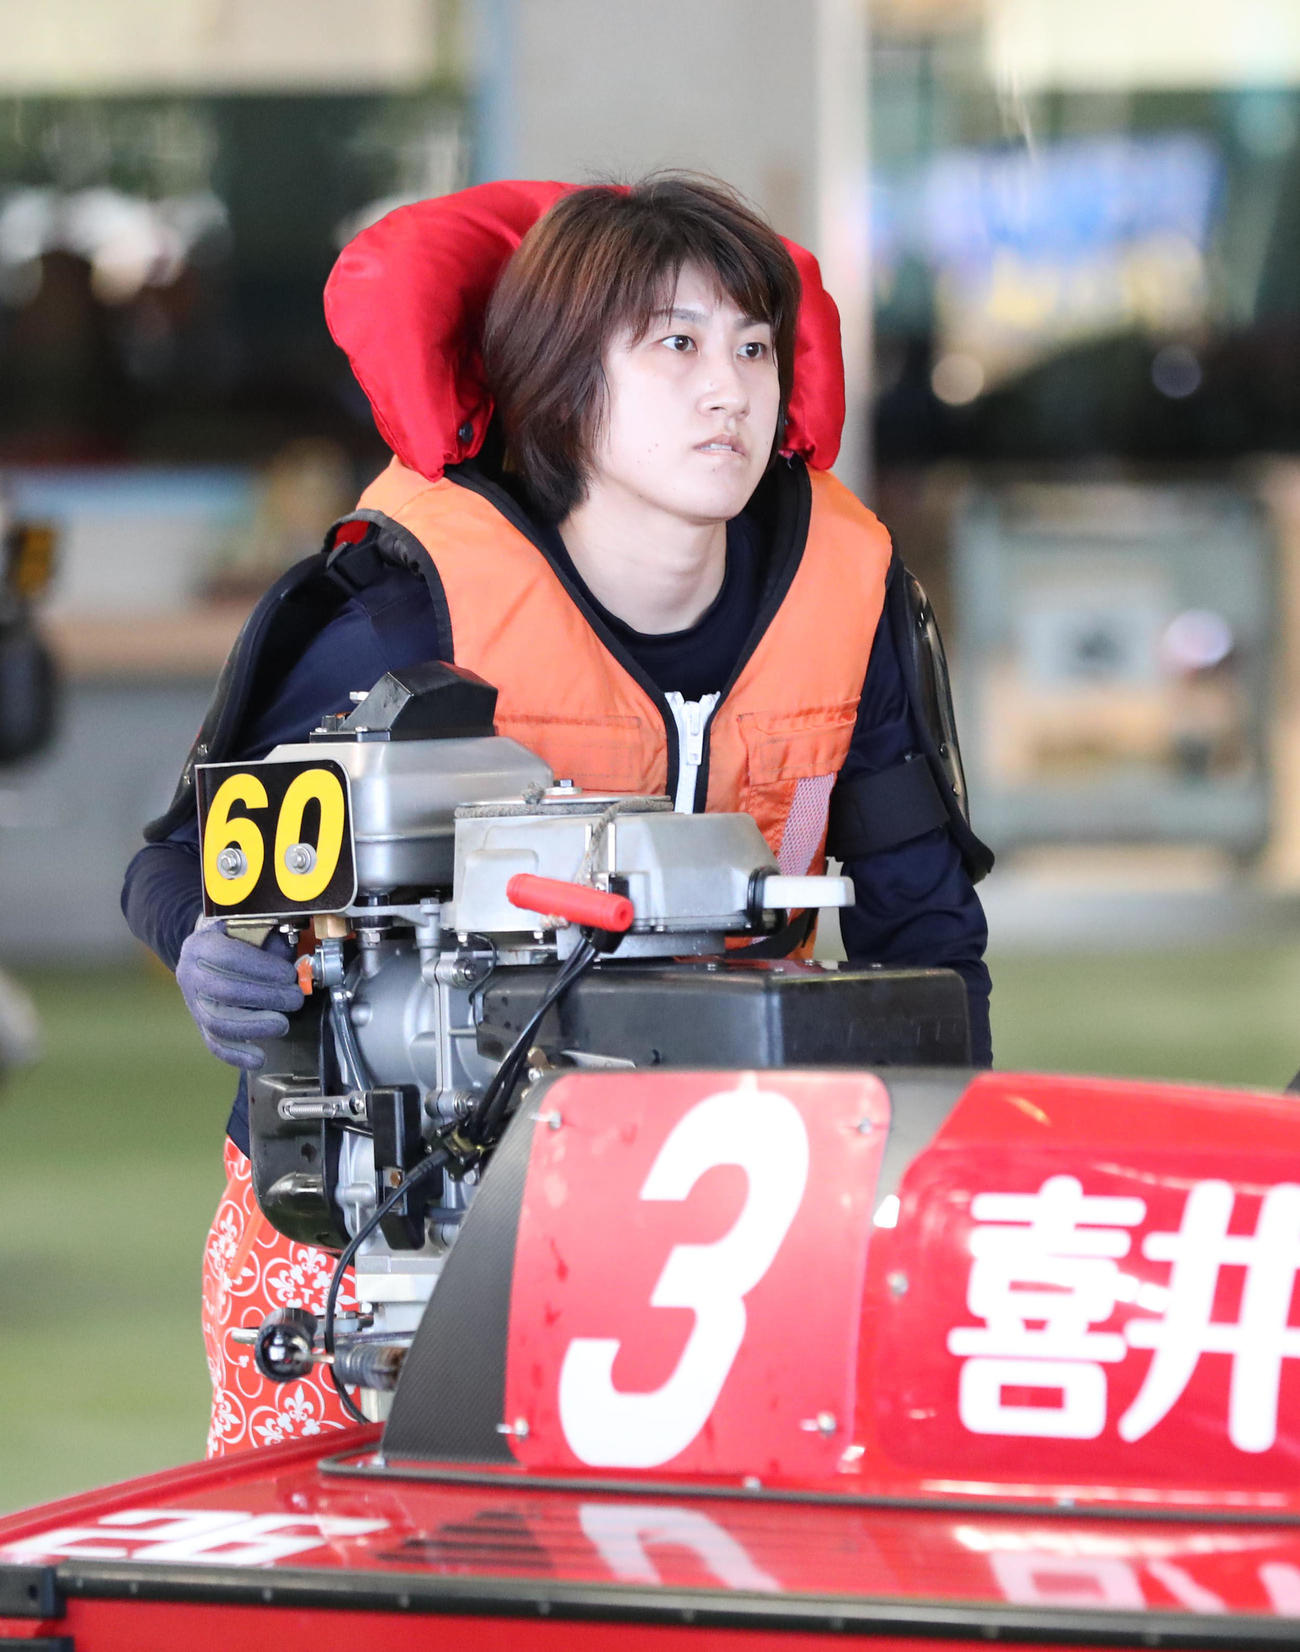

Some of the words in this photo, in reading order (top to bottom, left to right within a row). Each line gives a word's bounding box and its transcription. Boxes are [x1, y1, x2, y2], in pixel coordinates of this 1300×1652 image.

[204, 769, 345, 906] 60
[558, 1091, 810, 1468] 3
[947, 1174, 1300, 1453] 喜井
